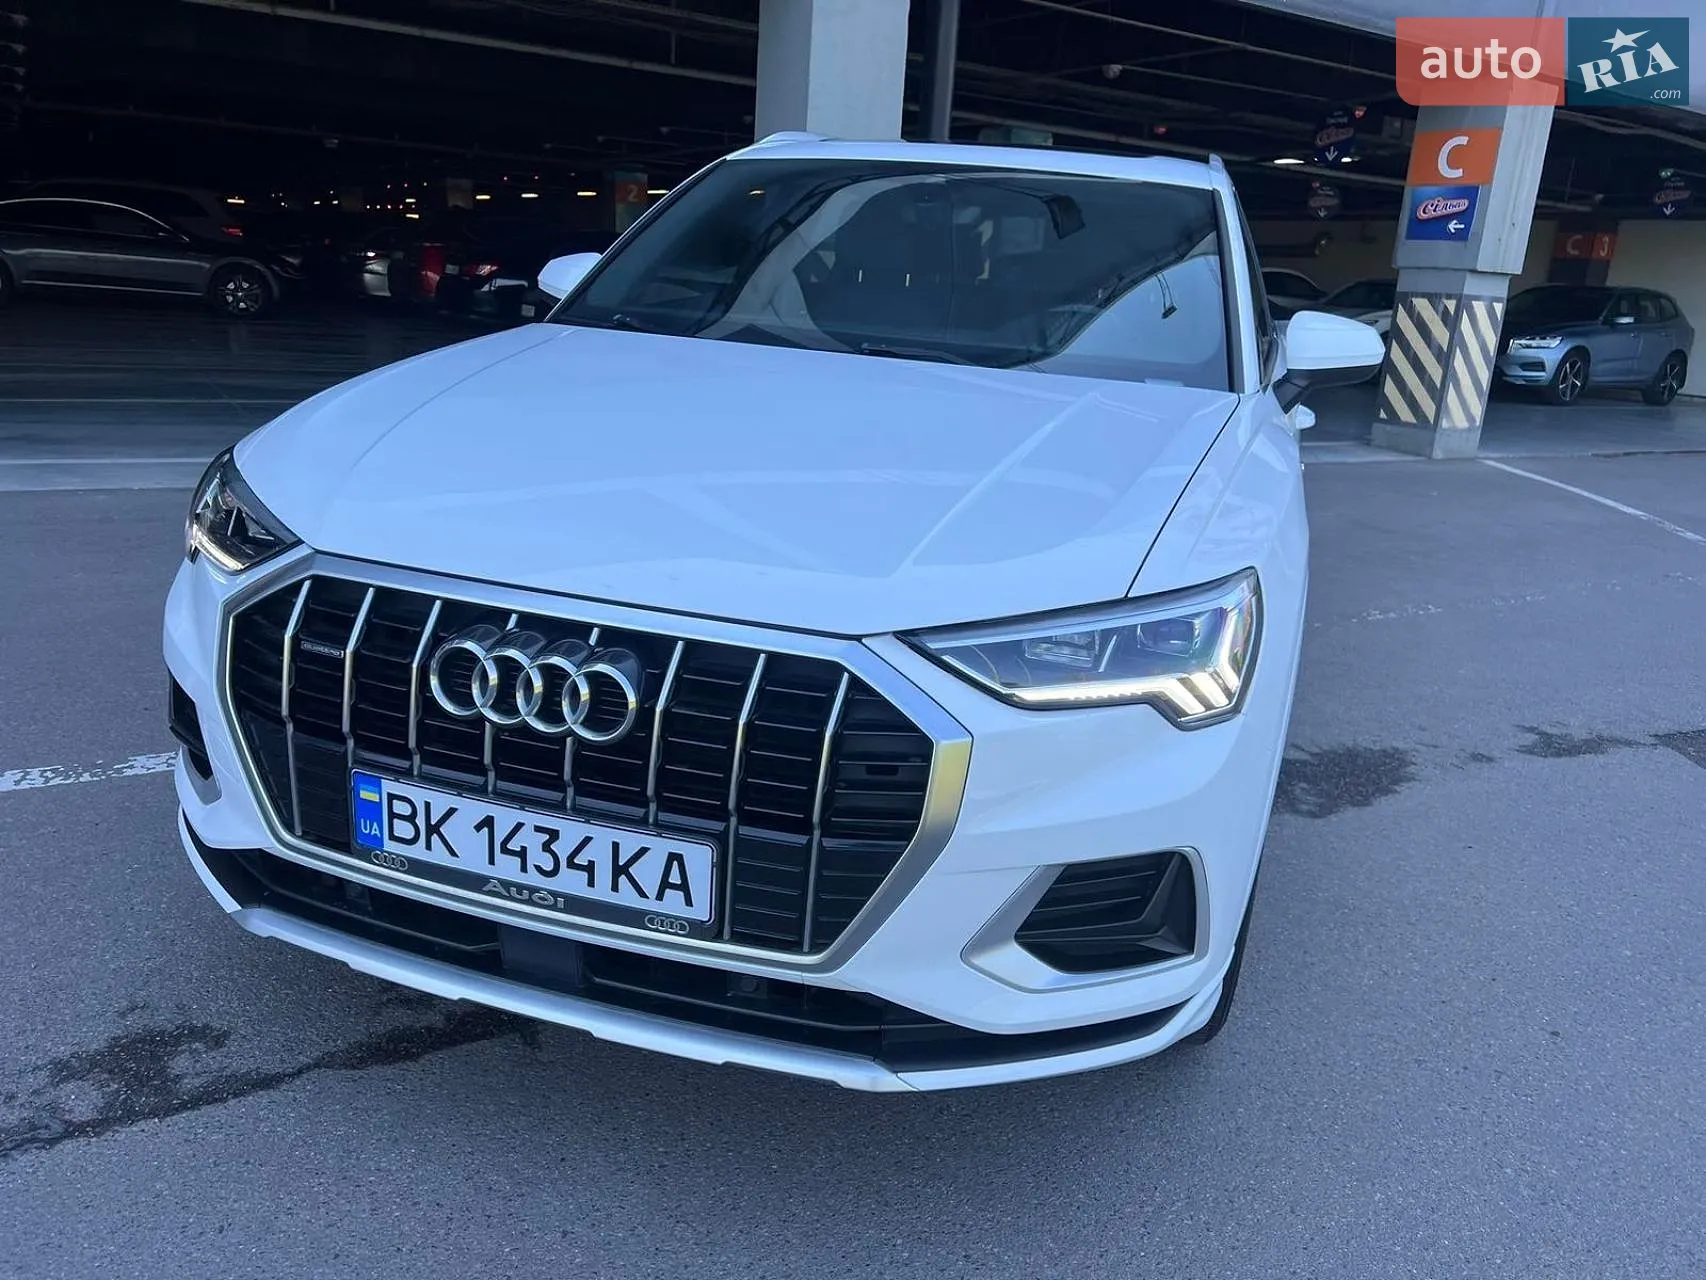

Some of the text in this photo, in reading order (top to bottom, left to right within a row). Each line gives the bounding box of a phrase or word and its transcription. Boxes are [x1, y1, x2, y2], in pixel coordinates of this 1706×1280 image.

[1437, 135, 1469, 178] C
[626, 184, 640, 203] 2
[360, 818, 382, 839] UA
[386, 791, 695, 908] BK 1434 KA
